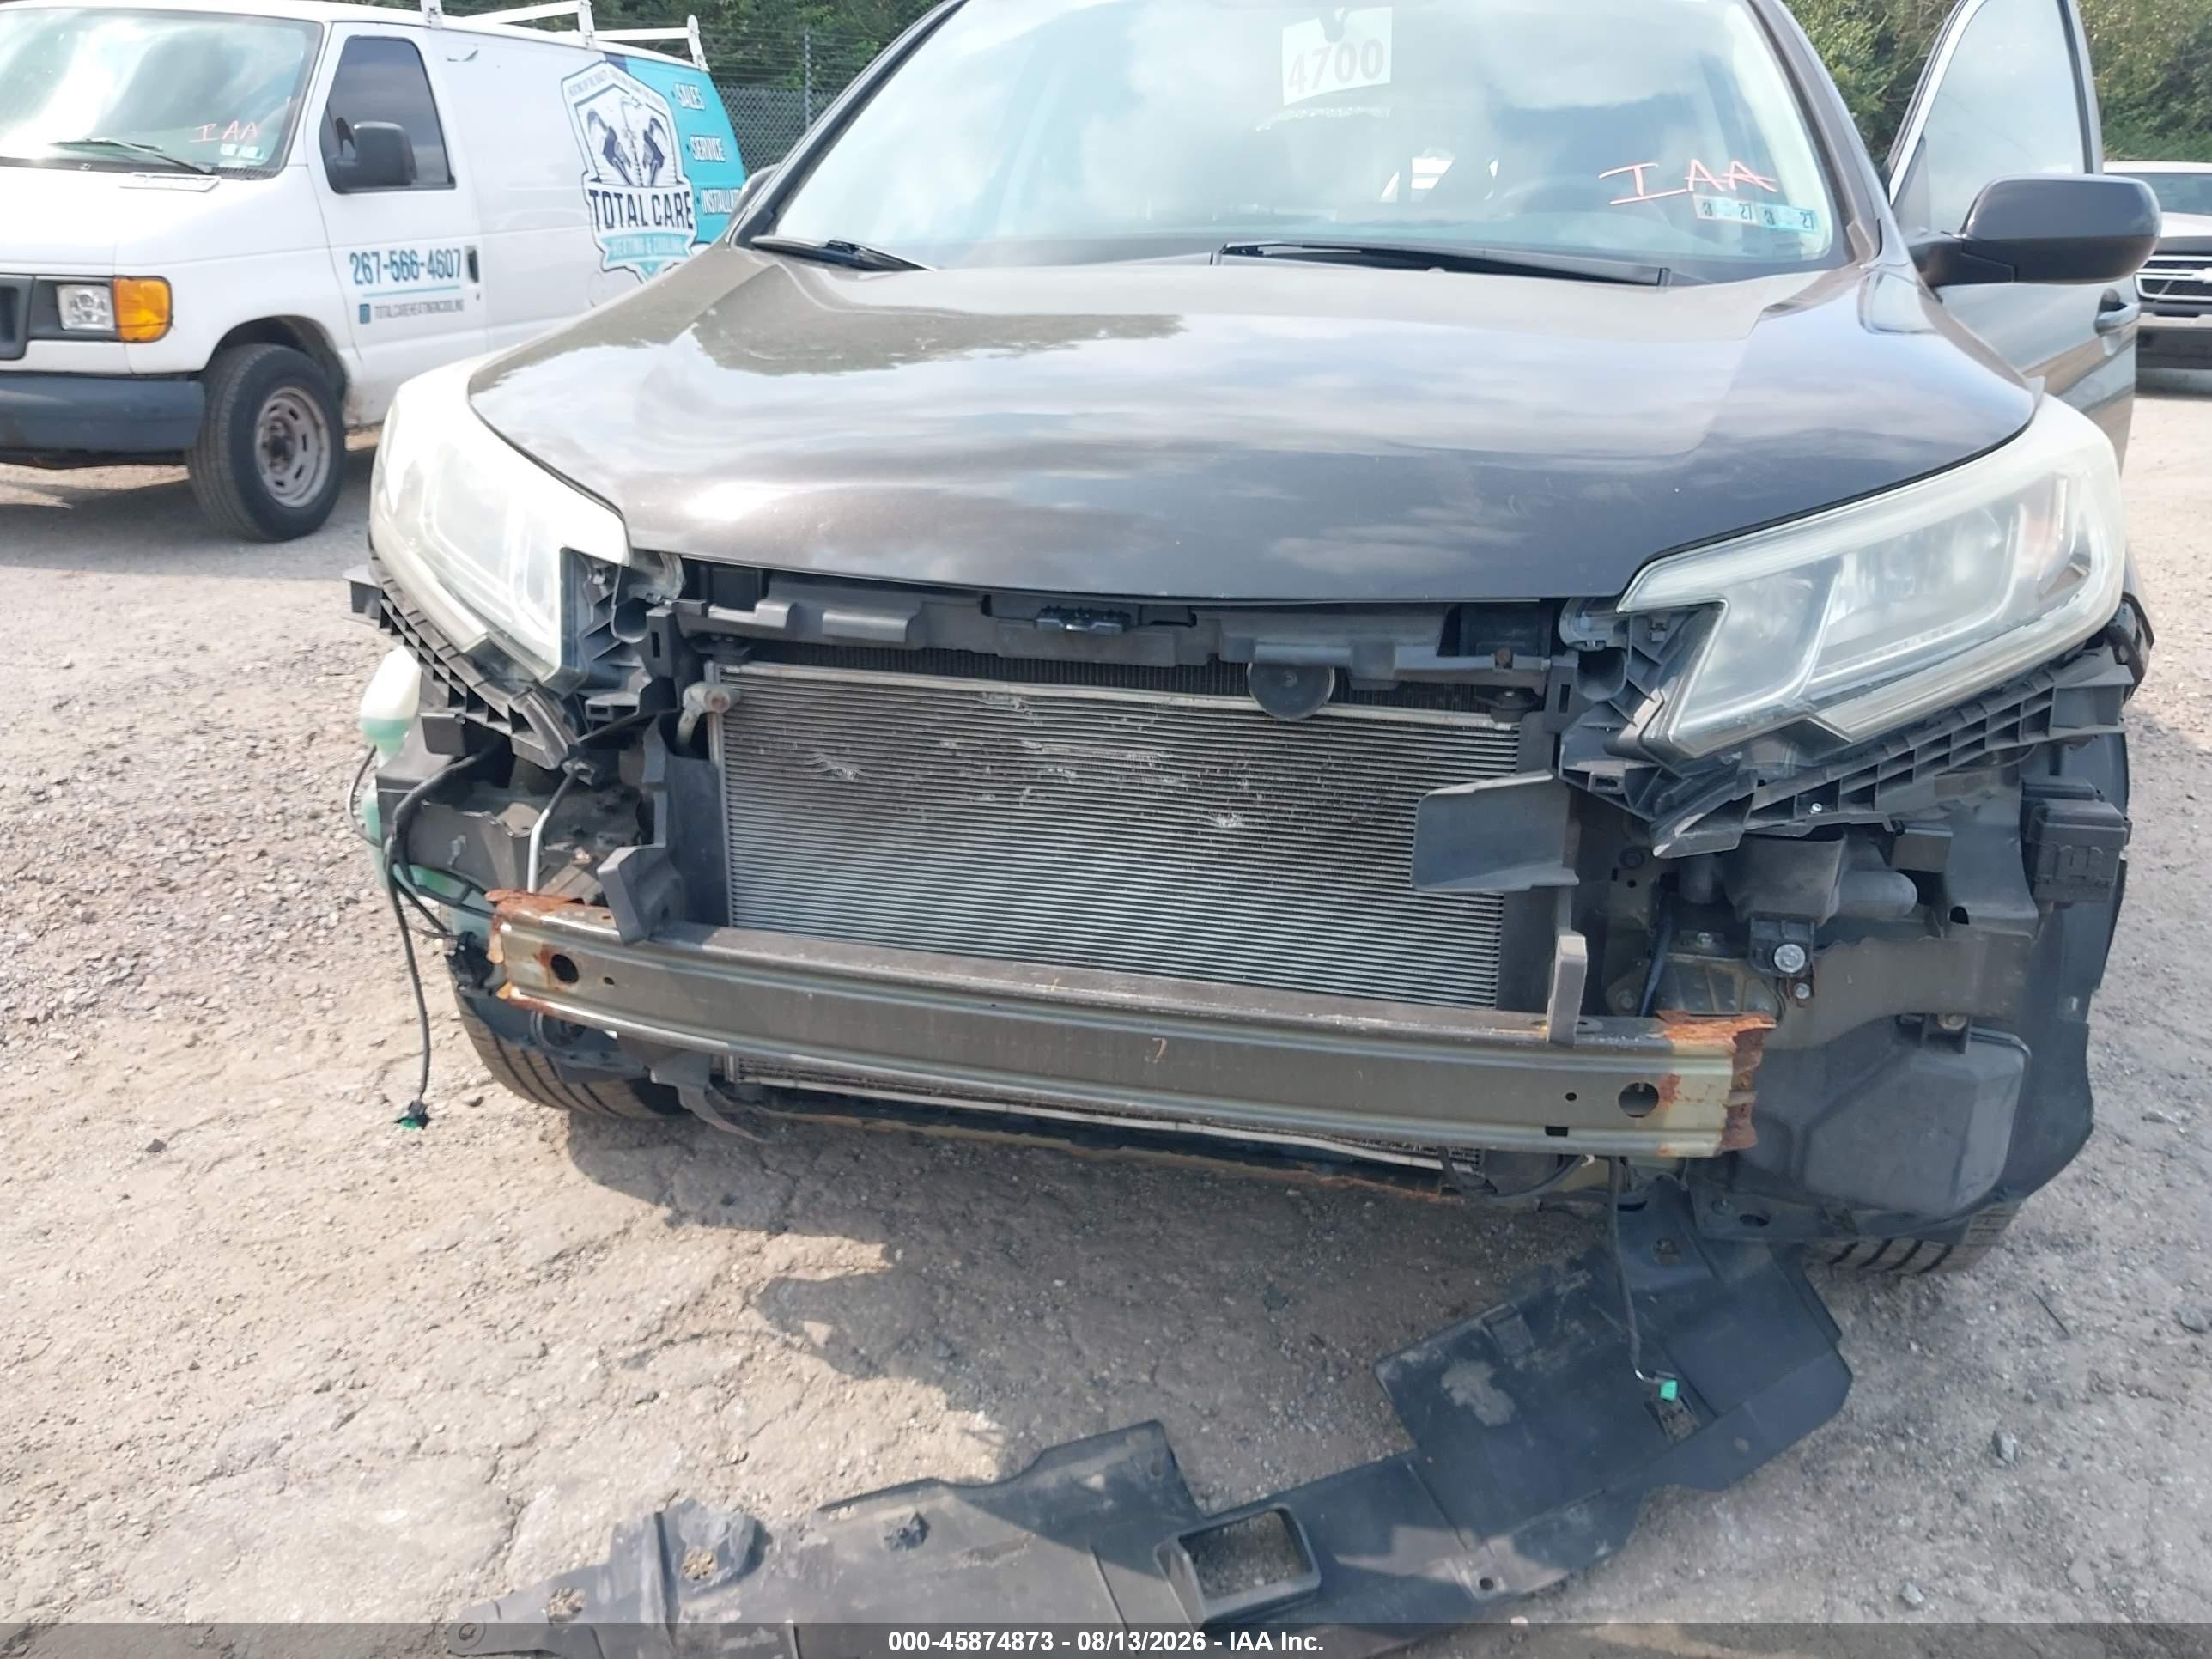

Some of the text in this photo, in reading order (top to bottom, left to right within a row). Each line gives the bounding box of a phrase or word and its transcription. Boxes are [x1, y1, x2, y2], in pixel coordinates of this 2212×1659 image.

[1288, 38, 1384, 94] 4700
[674, 82, 706, 110] SALES
[690, 135, 726, 162] SERVICE
[588, 188, 694, 233] TOTAL CARE
[349, 248, 461, 285] 267-566-4607
